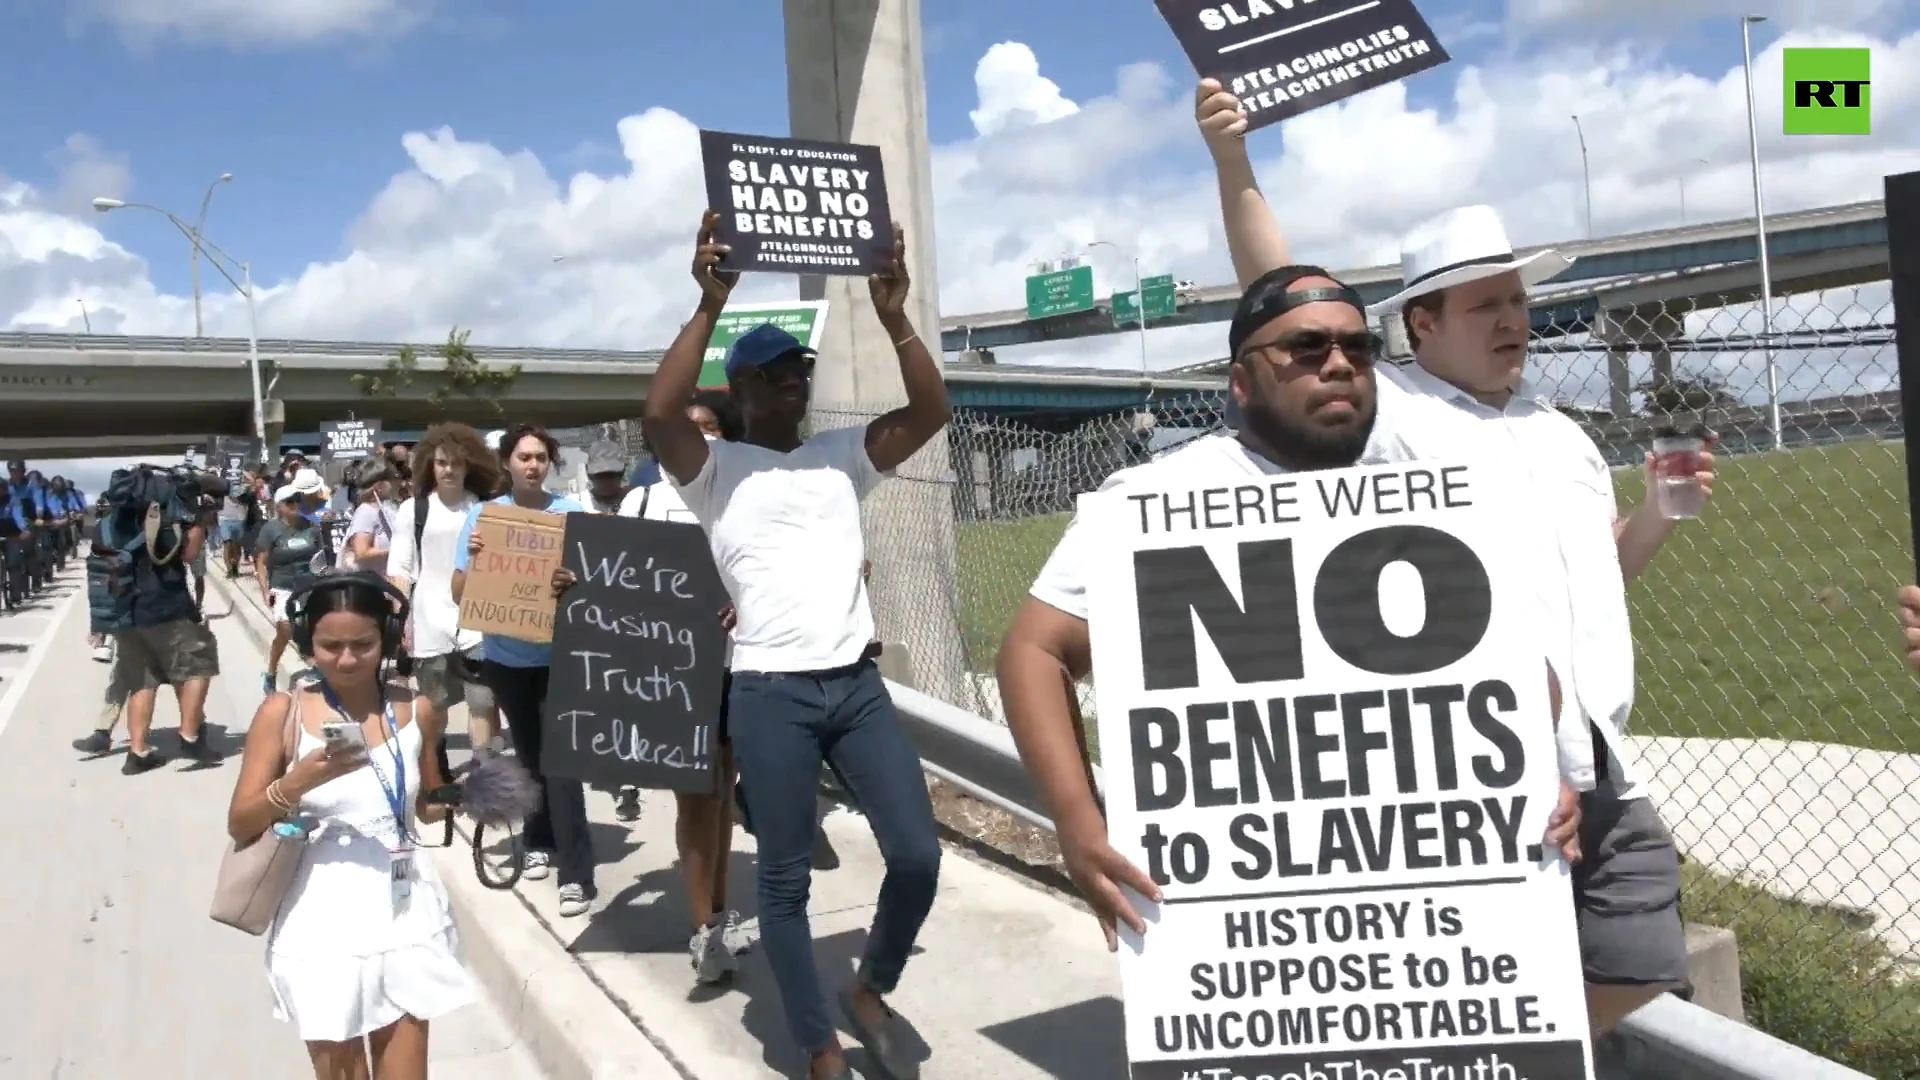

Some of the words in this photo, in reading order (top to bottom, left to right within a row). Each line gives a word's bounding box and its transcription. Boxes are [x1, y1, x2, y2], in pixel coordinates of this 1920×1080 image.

[1232, 25, 1410, 95] #TEACHNOLIES
[1238, 39, 1431, 112] TEACHTHETRUTH
[728, 159, 870, 190] SLAVERY
[748, 145, 779, 156] DEPT.
[780, 147, 795, 156] OF
[797, 149, 858, 162] EDUCATION
[731, 185, 807, 213] HAD
[819, 190, 869, 217] NO
[735, 212, 874, 239] BENEFITS
[757, 253, 860, 267] #TEACHTHETRUTH
[760, 240, 853, 255] #TEACHNOLIES
[1128, 481, 1300, 534] THERE
[1316, 466, 1473, 518] WERE
[510, 583, 544, 598] NOT
[577, 541, 694, 599] We're
[566, 598, 696, 671] raising
[1133, 524, 1492, 691] NO
[570, 650, 693, 712] Truth
[557, 709, 709, 770] Tellers!!
[1129, 679, 1526, 812] BENEFITS
[1141, 823, 1210, 887] to
[1228, 795, 1543, 881] SLAVERY.
[1224, 901, 1411, 949] HISTORY
[1423, 898, 1464, 938] is
[1190, 953, 1393, 1001] SUPPOSE
[1404, 950, 1450, 989] to
[1461, 945, 1519, 987] be
[1154, 995, 1557, 1053] UNCOMFORTABLE.
